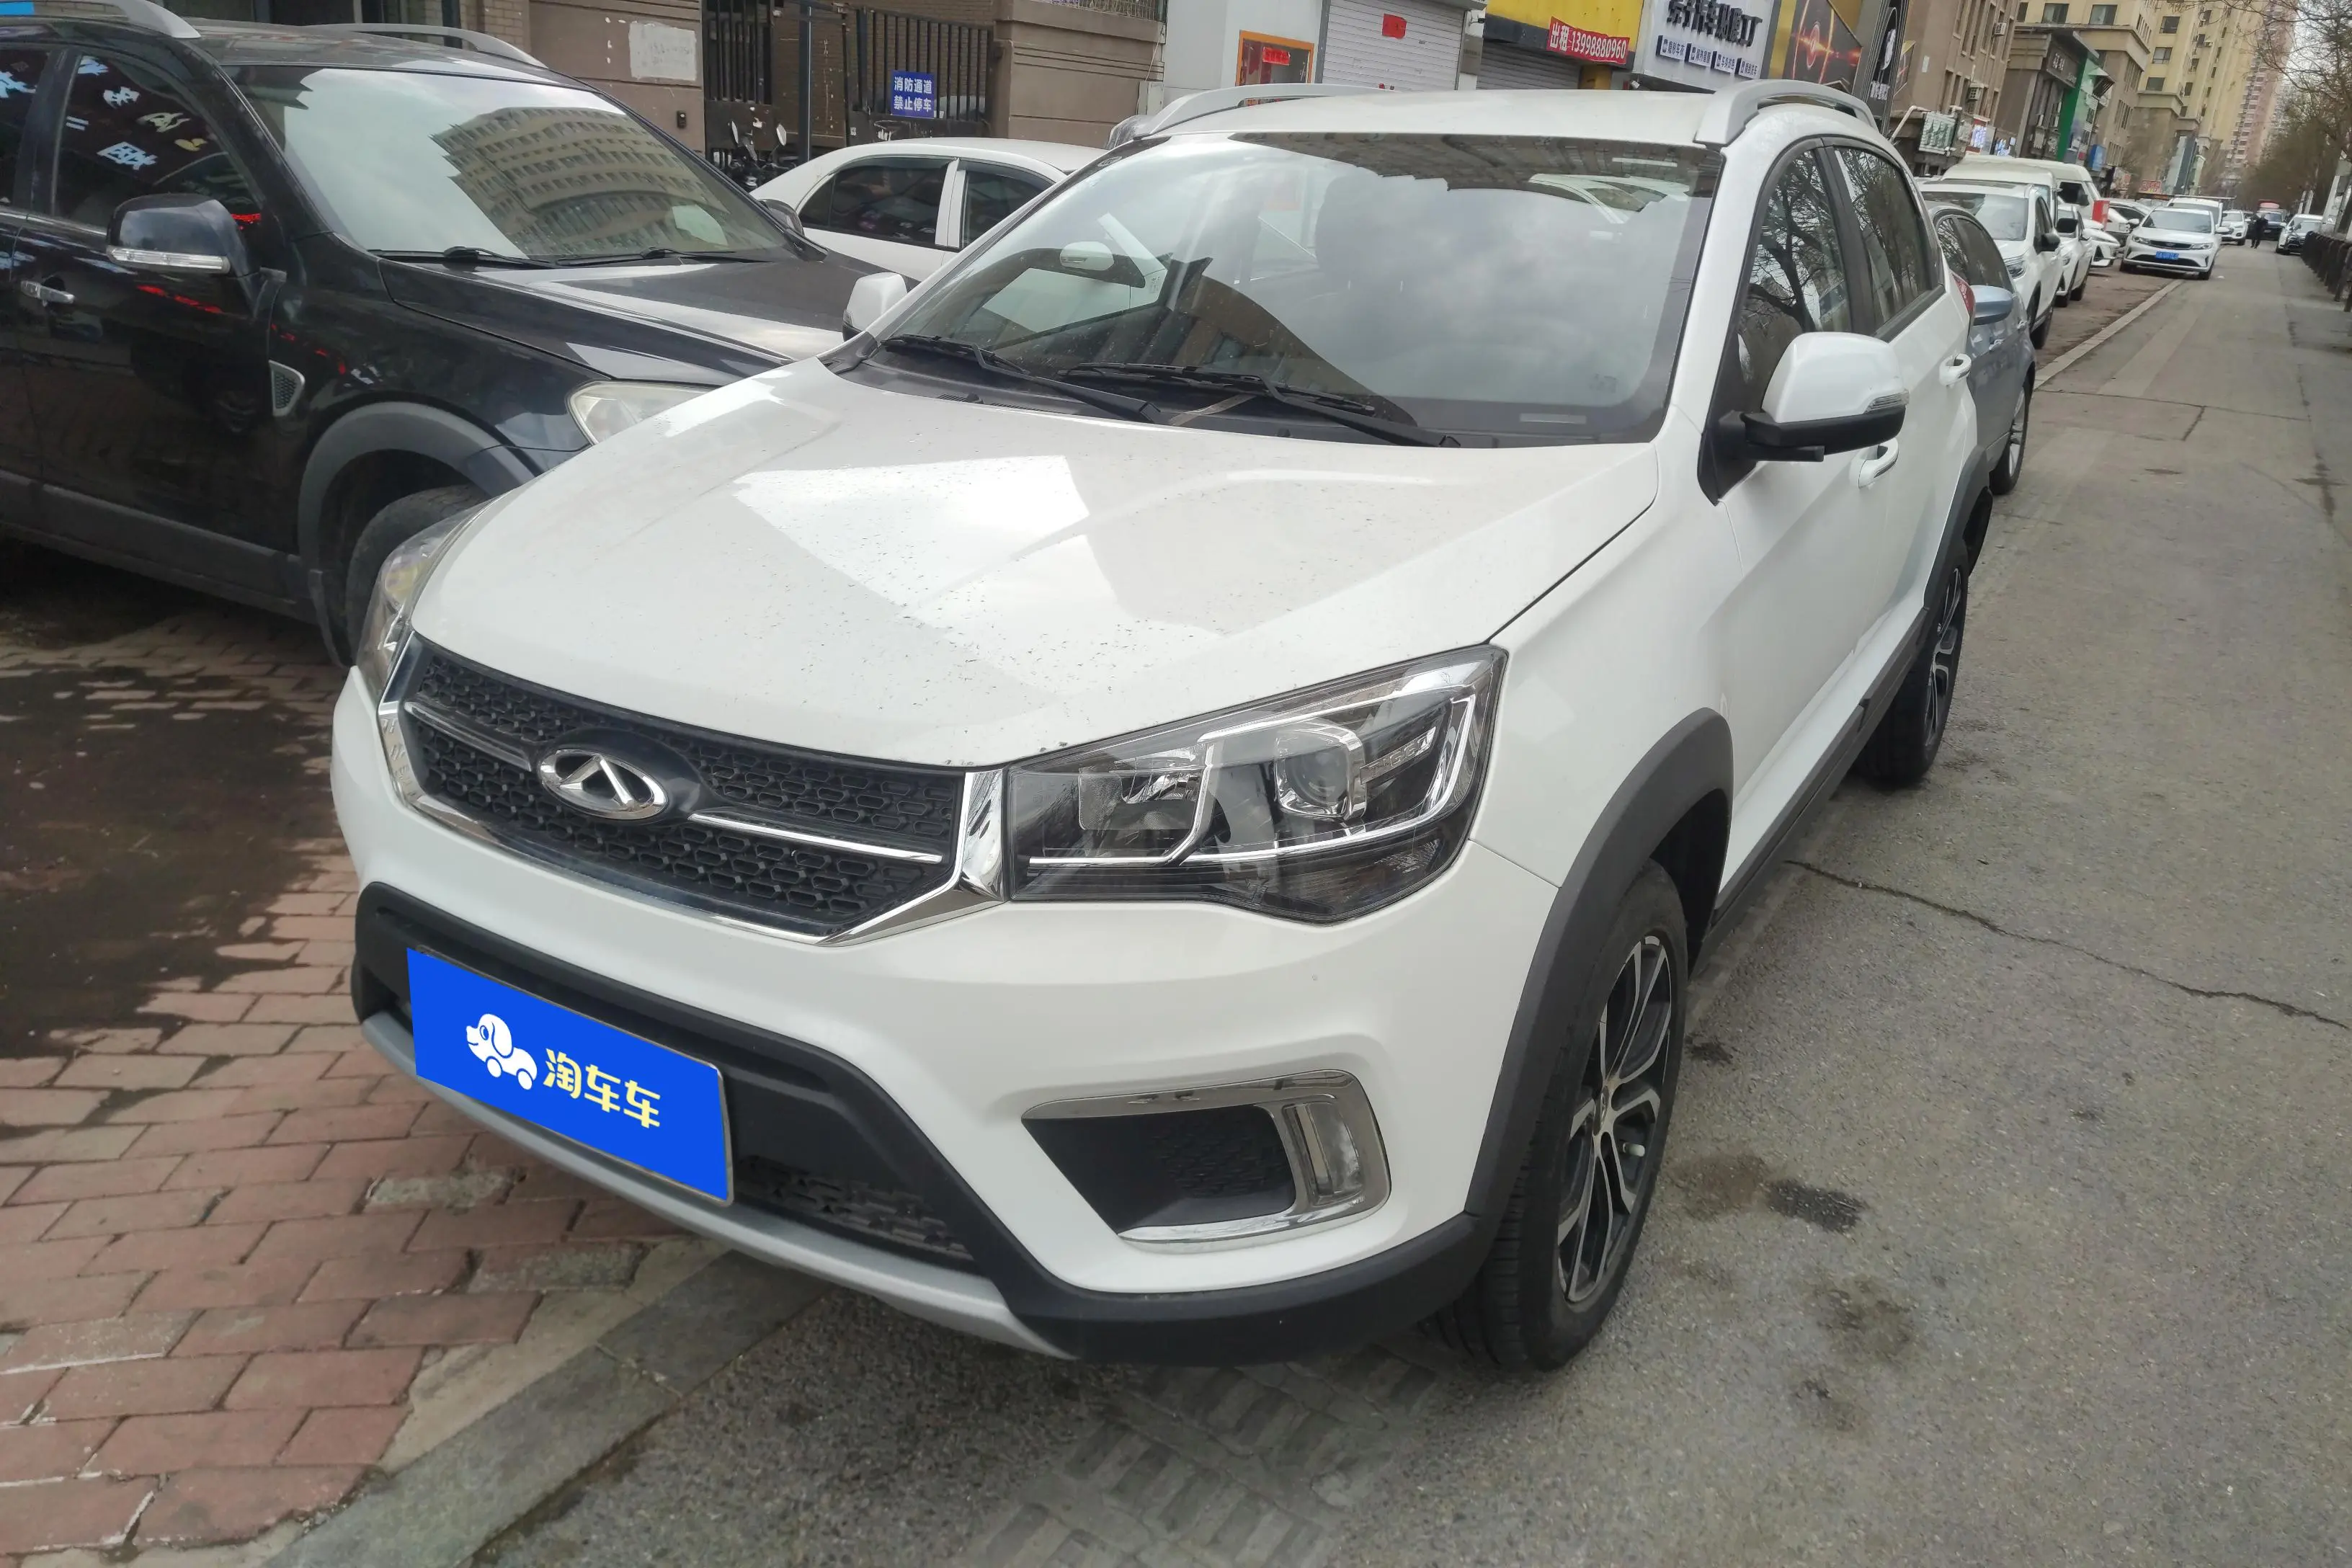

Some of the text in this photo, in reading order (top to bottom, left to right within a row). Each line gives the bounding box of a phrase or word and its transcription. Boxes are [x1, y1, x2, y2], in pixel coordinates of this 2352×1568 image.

[1550, 22, 1626, 59] 出租 13998880960
[894, 76, 932, 94] 消防通道
[894, 96, 932, 112] 禁止停车
